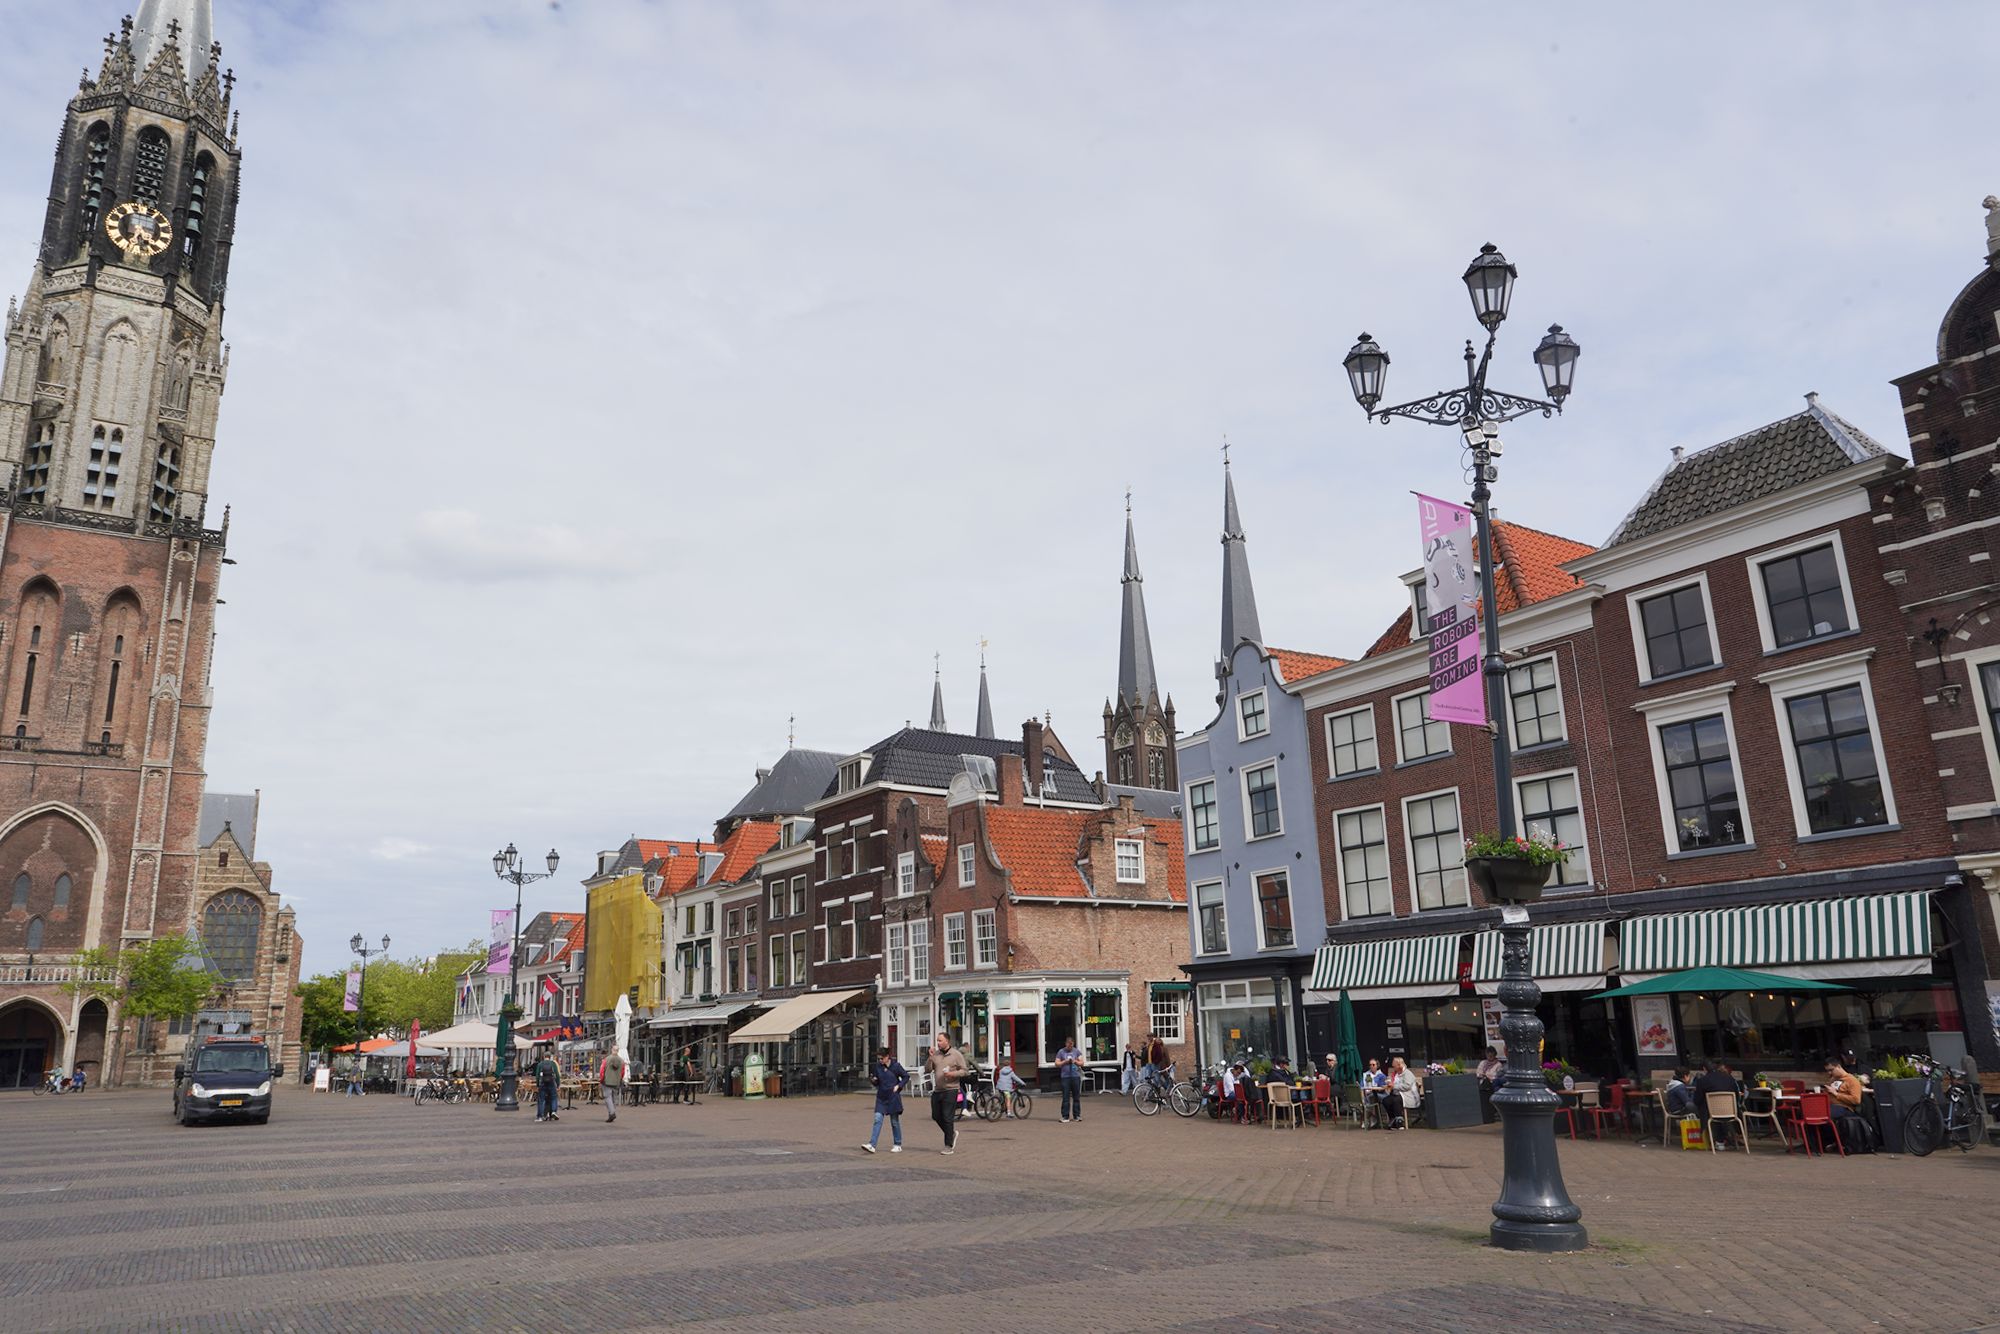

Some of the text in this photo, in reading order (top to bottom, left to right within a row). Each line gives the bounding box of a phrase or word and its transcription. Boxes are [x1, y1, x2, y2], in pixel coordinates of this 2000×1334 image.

[1433, 608, 1456, 629] THE
[1434, 618, 1475, 651] ROBOTS
[1434, 648, 1456, 671] ARE
[1434, 658, 1476, 690] COMING
